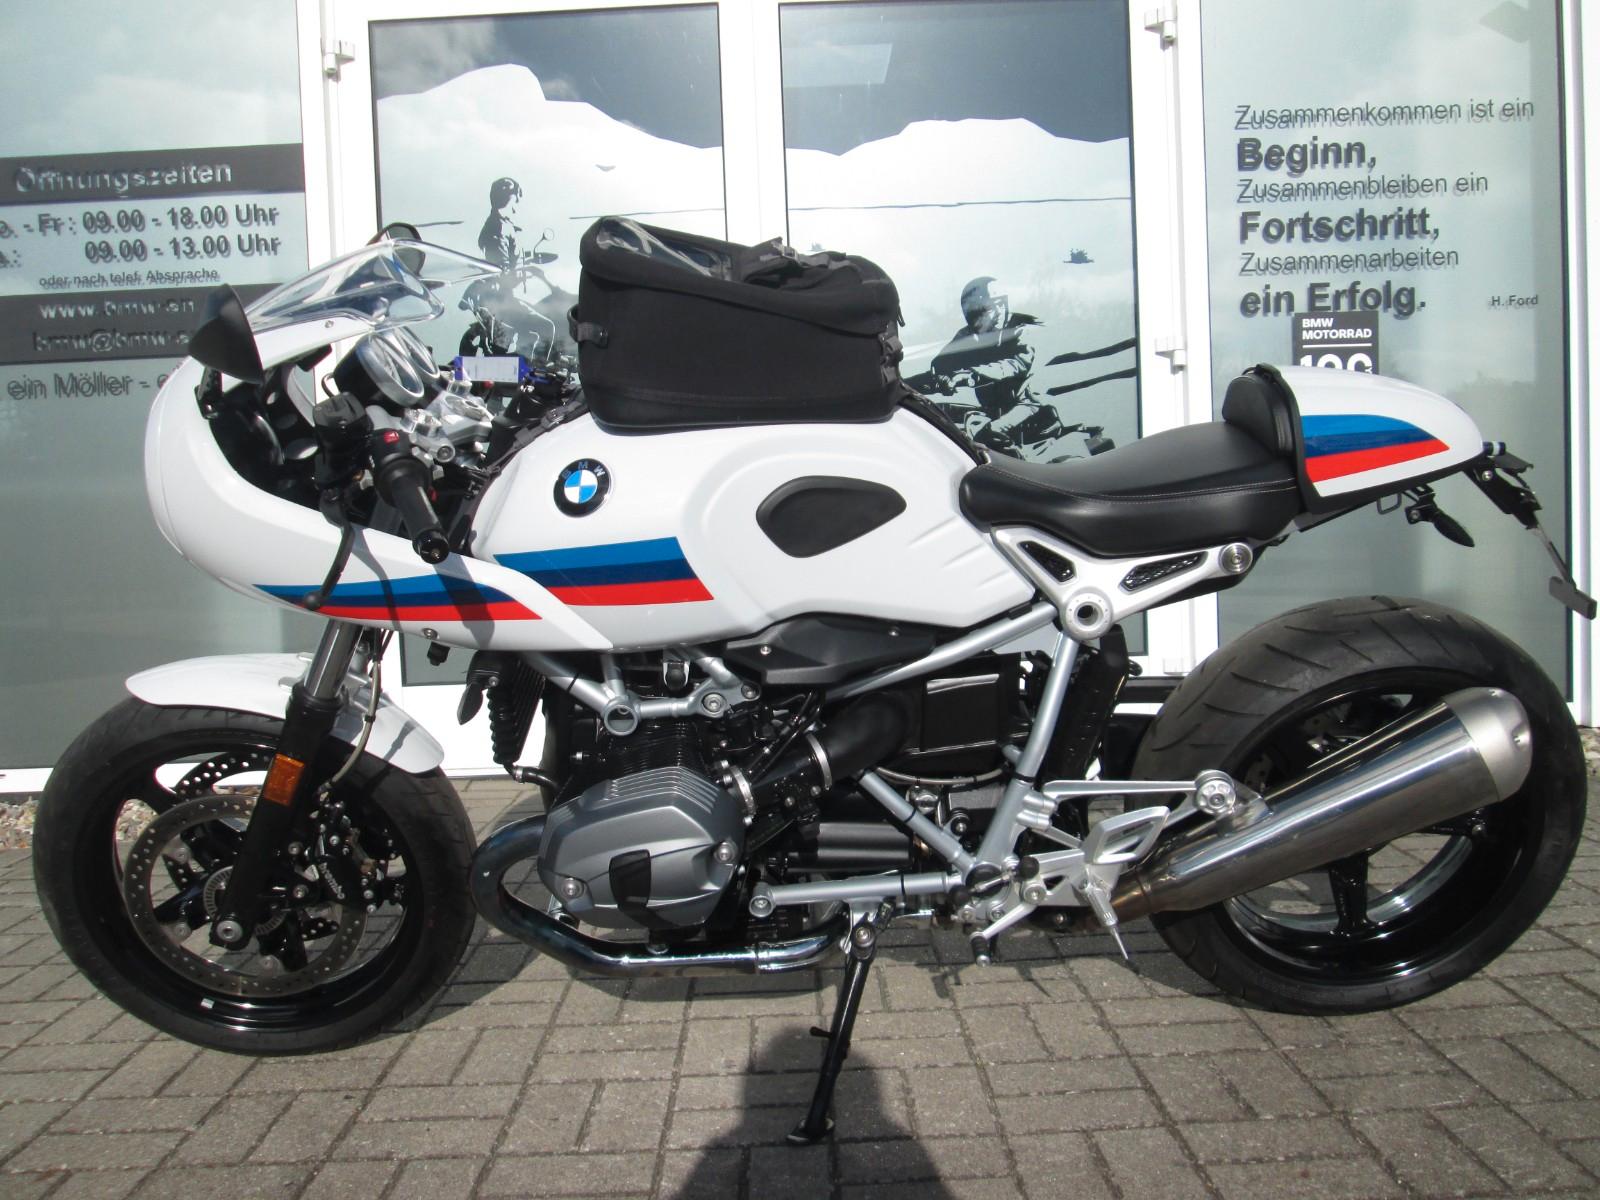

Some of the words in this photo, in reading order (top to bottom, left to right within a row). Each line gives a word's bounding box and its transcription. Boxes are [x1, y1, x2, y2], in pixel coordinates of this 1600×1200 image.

[1235, 101, 1461, 129] Zusammenkommen
[1468, 98, 1494, 121] ist
[1501, 97, 1535, 120] ein
[1237, 135, 1376, 176] Beginn,
[15, 162, 232, 200] Öffnungszeiten
[1237, 174, 1447, 202] Zusammenbleiben
[1455, 172, 1488, 195] ein
[82, 209, 145, 234] 09.00
[167, 205, 228, 230] 18.00
[235, 203, 279, 227] Uhr
[1239, 206, 1439, 243] Fortschritt,
[84, 239, 147, 264] 09.00
[169, 235, 231, 259] 13.00
[237, 233, 281, 257] Uhr
[1239, 247, 1459, 276] Zusammenarbeiten
[39, 275, 72, 289] oder
[73, 273, 109, 288] nach
[146, 268, 220, 287] Absprache
[1240, 284, 1295, 317] ein
[1308, 280, 1426, 319] Erfolg.
[1509, 295, 1539, 307] Ford
[1302, 318, 1334, 328] BMW
[1302, 328, 1372, 340] MOTORRAD
[7, 374, 47, 400] ein
[54, 371, 133, 398] Möller
[561, 461, 606, 481] BMW
